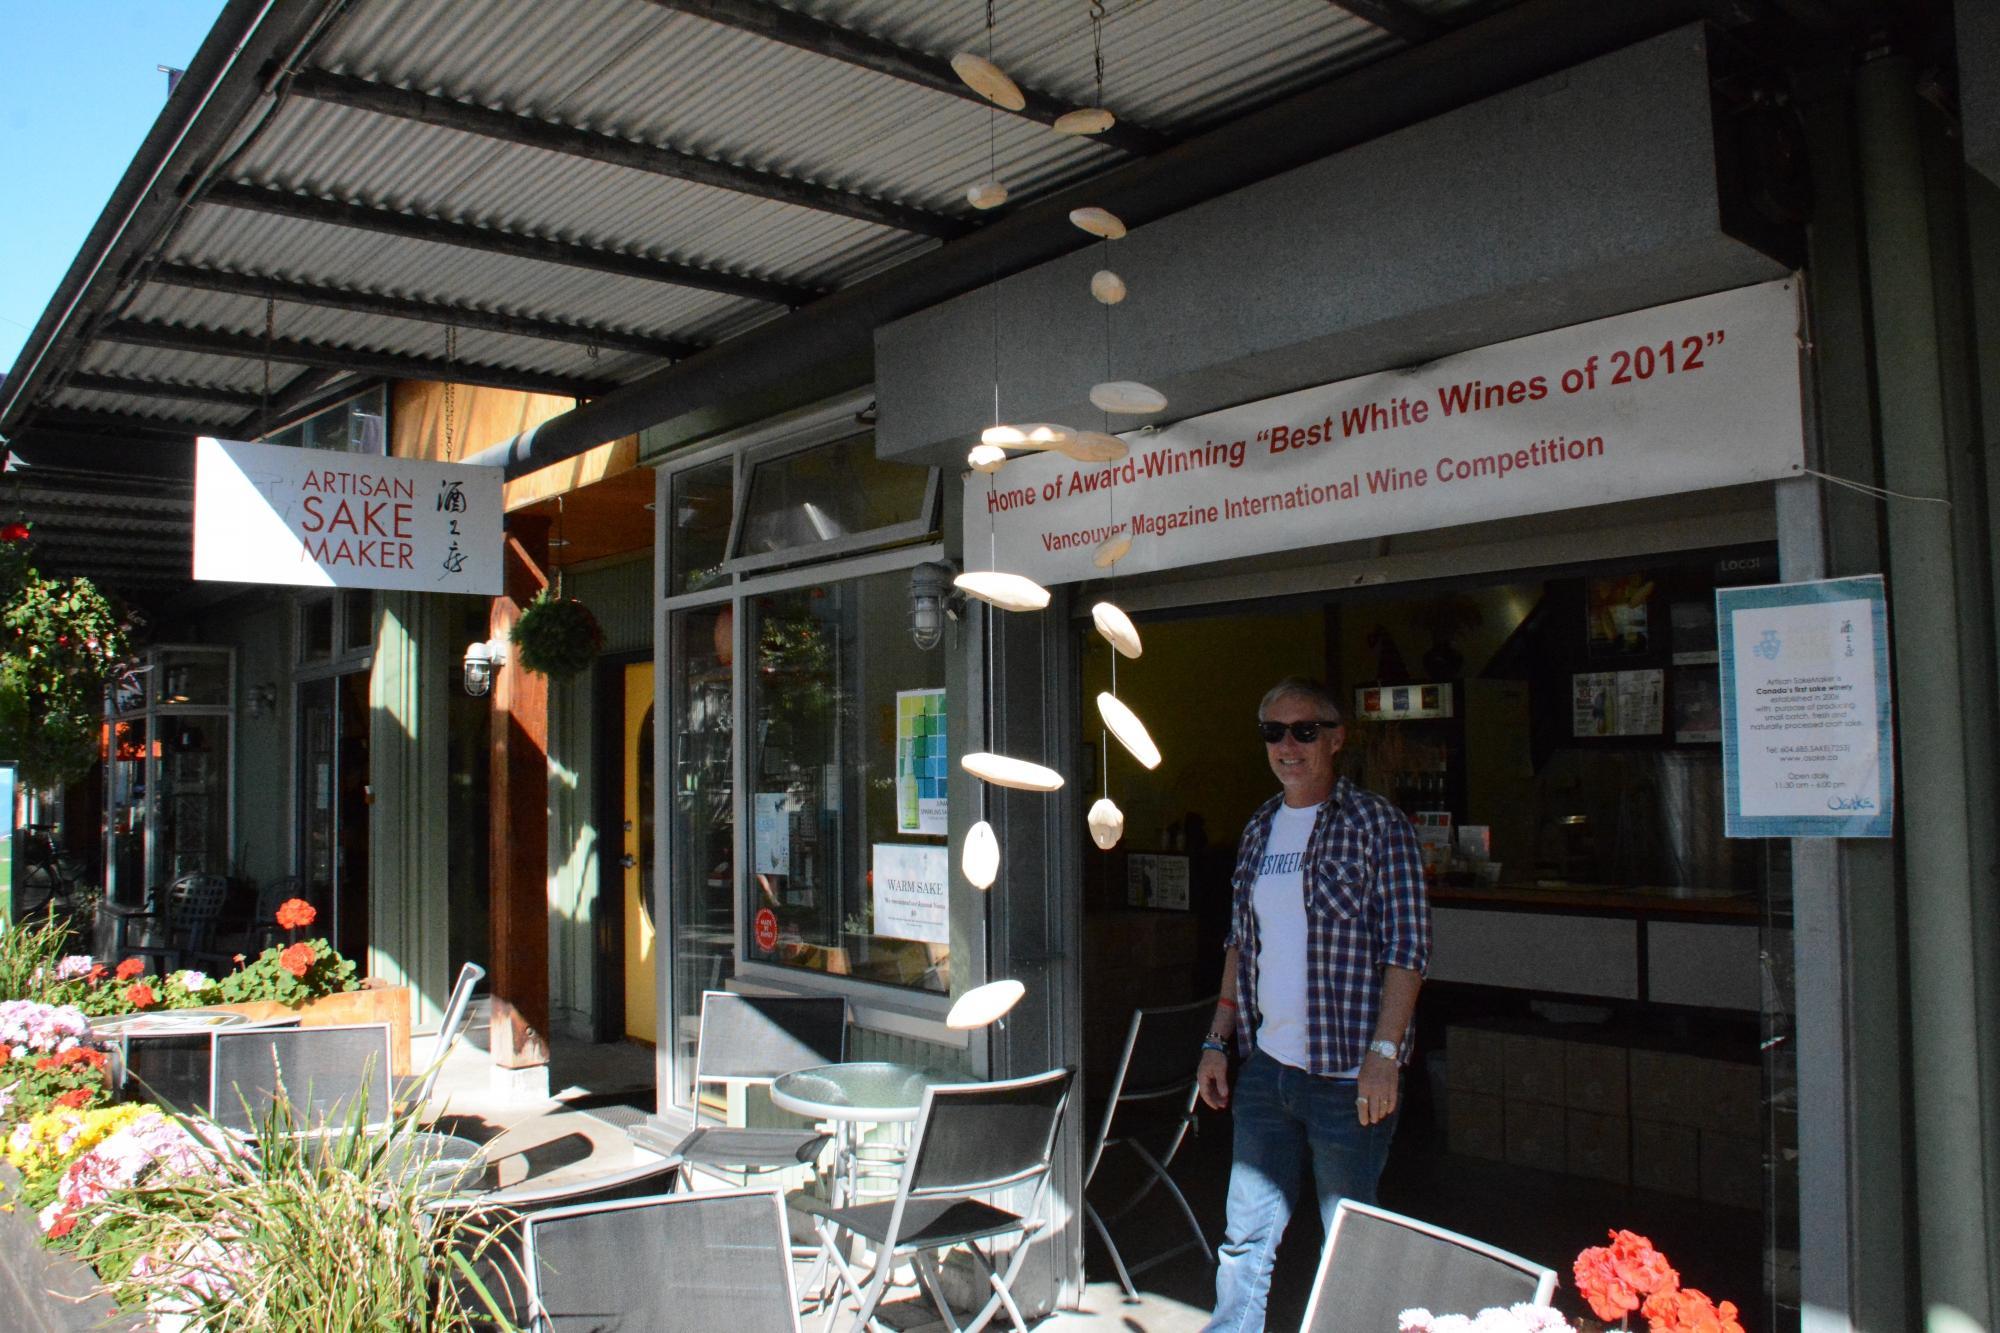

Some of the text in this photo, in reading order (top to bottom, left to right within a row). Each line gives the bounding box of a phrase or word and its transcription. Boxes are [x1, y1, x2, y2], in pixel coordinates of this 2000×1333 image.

[988, 488, 1036, 513] Home
[1043, 475, 1063, 501] of
[1068, 438, 1246, 496] Award-Winning
[1342, 398, 1429, 437] White
[1438, 381, 1548, 416] Wines
[1561, 355, 1598, 394] of
[302, 470, 414, 500] ARTISAN
[1042, 435, 1604, 553] Vancouver Magazine International Wine Competition
[302, 496, 414, 539] SAKE
[301, 537, 414, 569] MAKER
[1794, 686, 1808, 694] first
[1808, 685, 1827, 693] sake
[1787, 772, 1810, 781] Open
[888, 879, 944, 896] WARM SAKE
